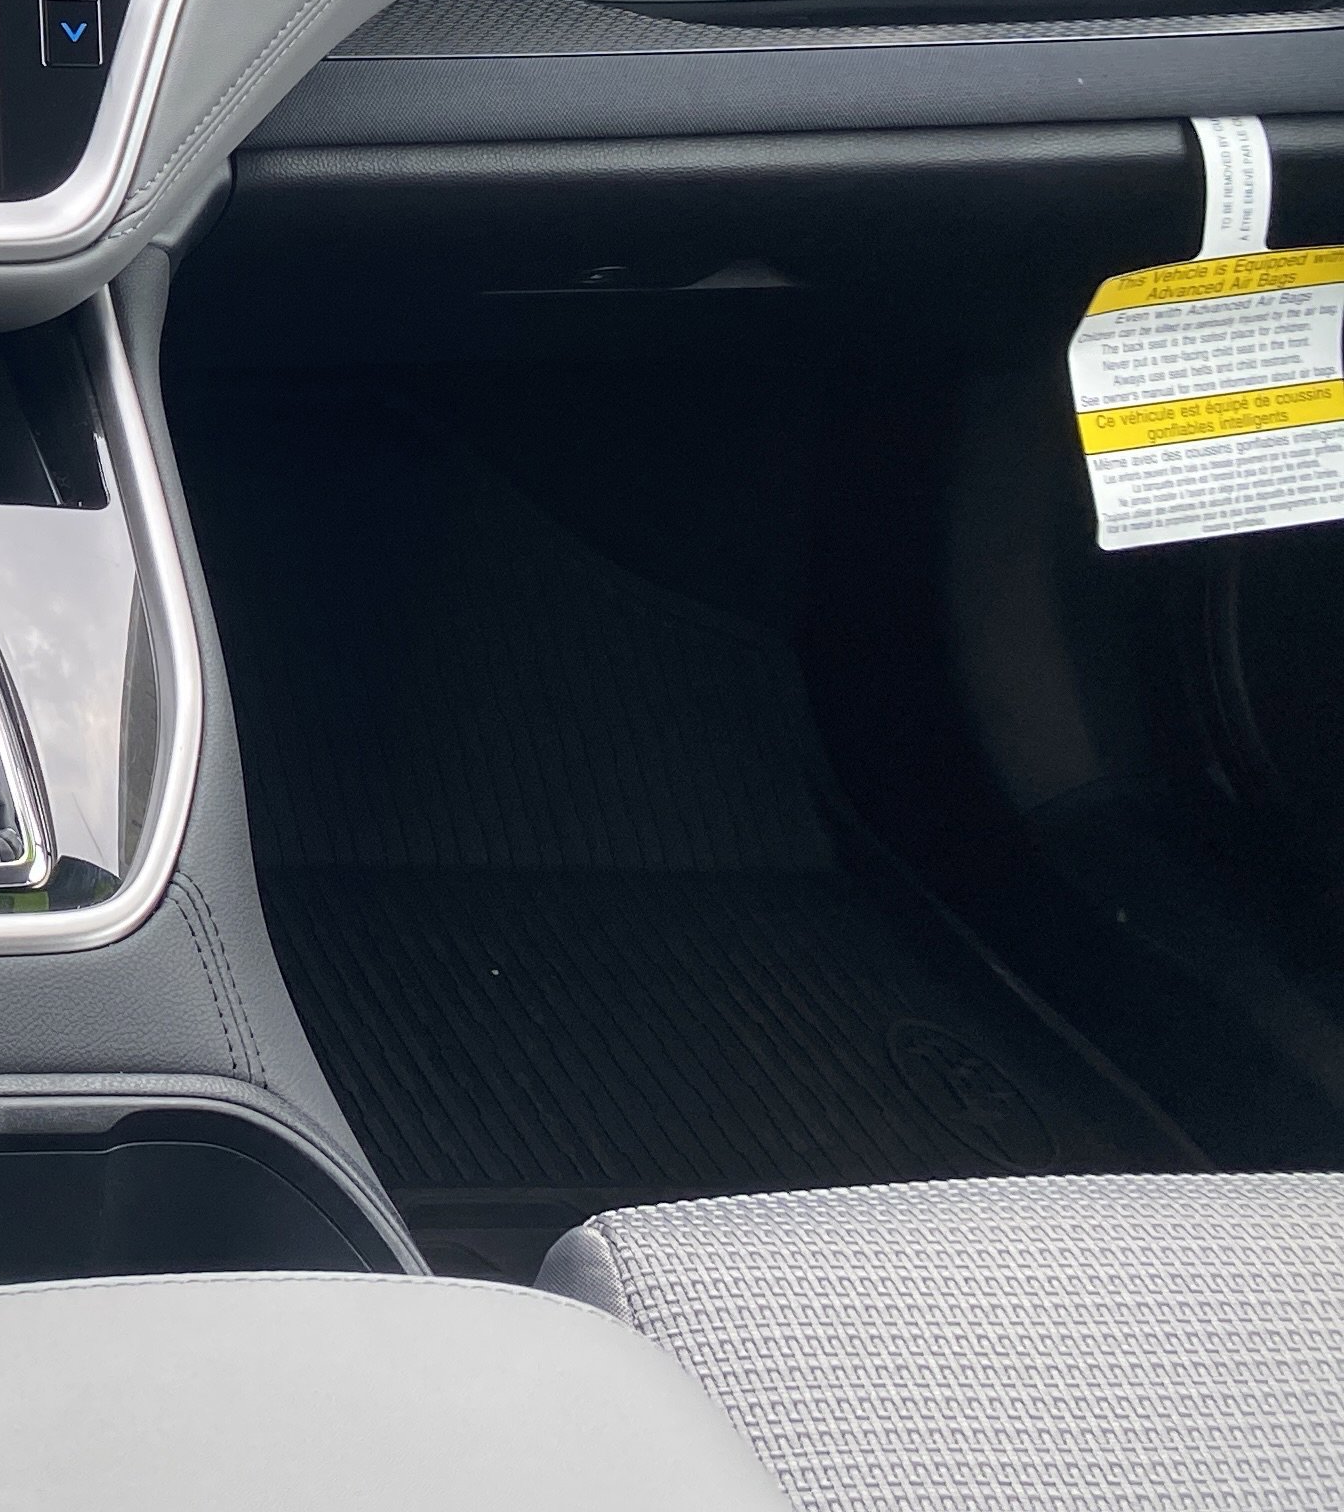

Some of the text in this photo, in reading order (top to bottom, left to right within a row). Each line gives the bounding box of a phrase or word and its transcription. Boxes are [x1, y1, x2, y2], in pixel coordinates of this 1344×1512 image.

[1117, 275, 1146, 291] This
[1153, 266, 1207, 285] Vehicle
[1213, 263, 1227, 276] is
[1234, 253, 1307, 274] Equipped
[1146, 272, 1299, 301] Advanced Air Bags
[1186, 299, 1252, 316] Advanced
[1095, 386, 1332, 429] Ce véhicule est équipé de coussins
[1147, 410, 1289, 444] gonflables intelligents
